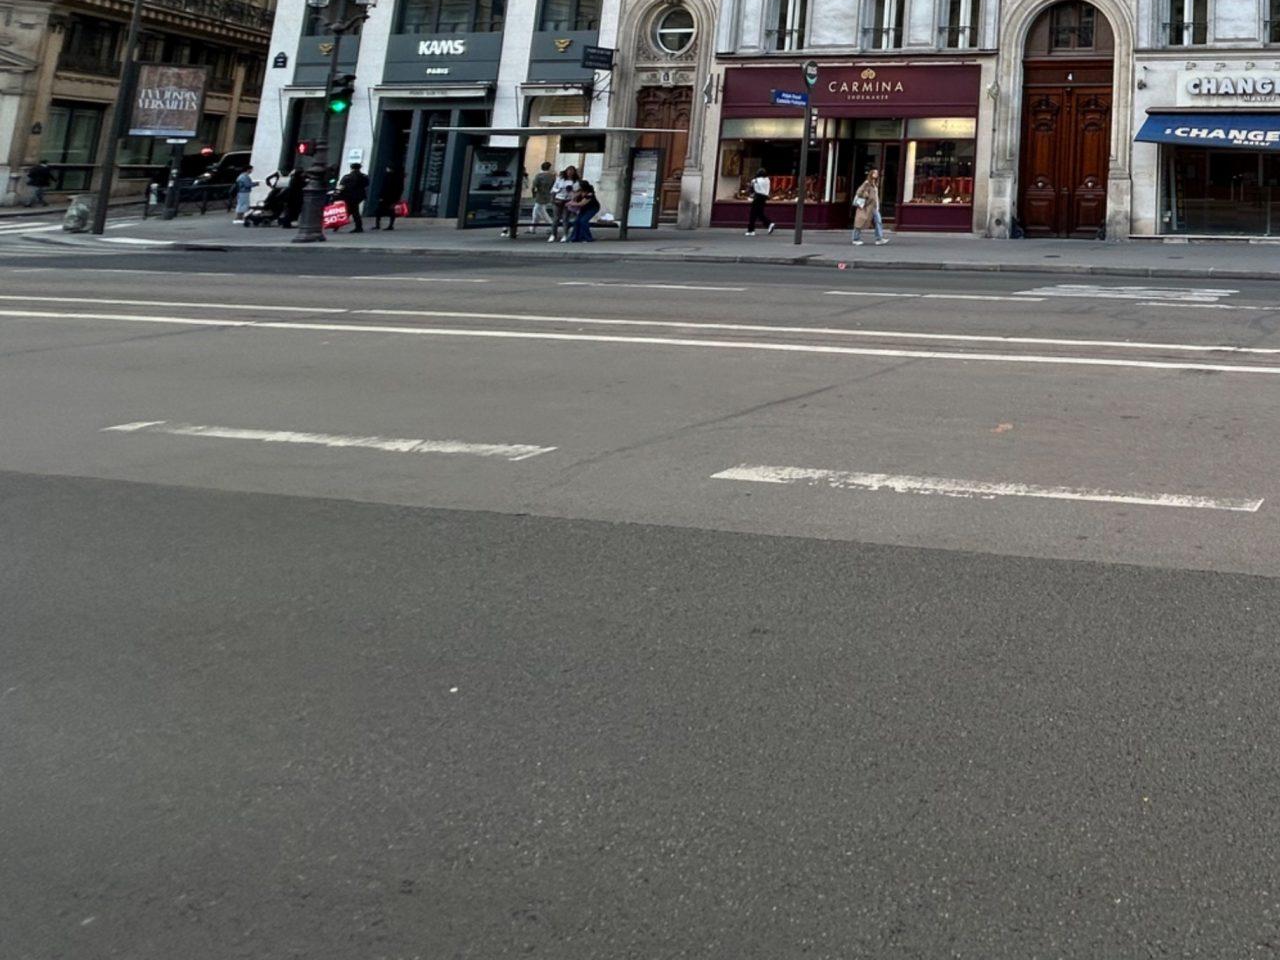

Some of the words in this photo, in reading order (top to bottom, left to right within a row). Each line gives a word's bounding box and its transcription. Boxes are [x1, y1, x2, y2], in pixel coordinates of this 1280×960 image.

[418, 39, 464, 55] KAMS
[1067, 73, 1073, 81] 4
[828, 81, 904, 93] CARMINA
[138, 98, 197, 110] VERSAILLES
[1243, 94, 1276, 103] Master
